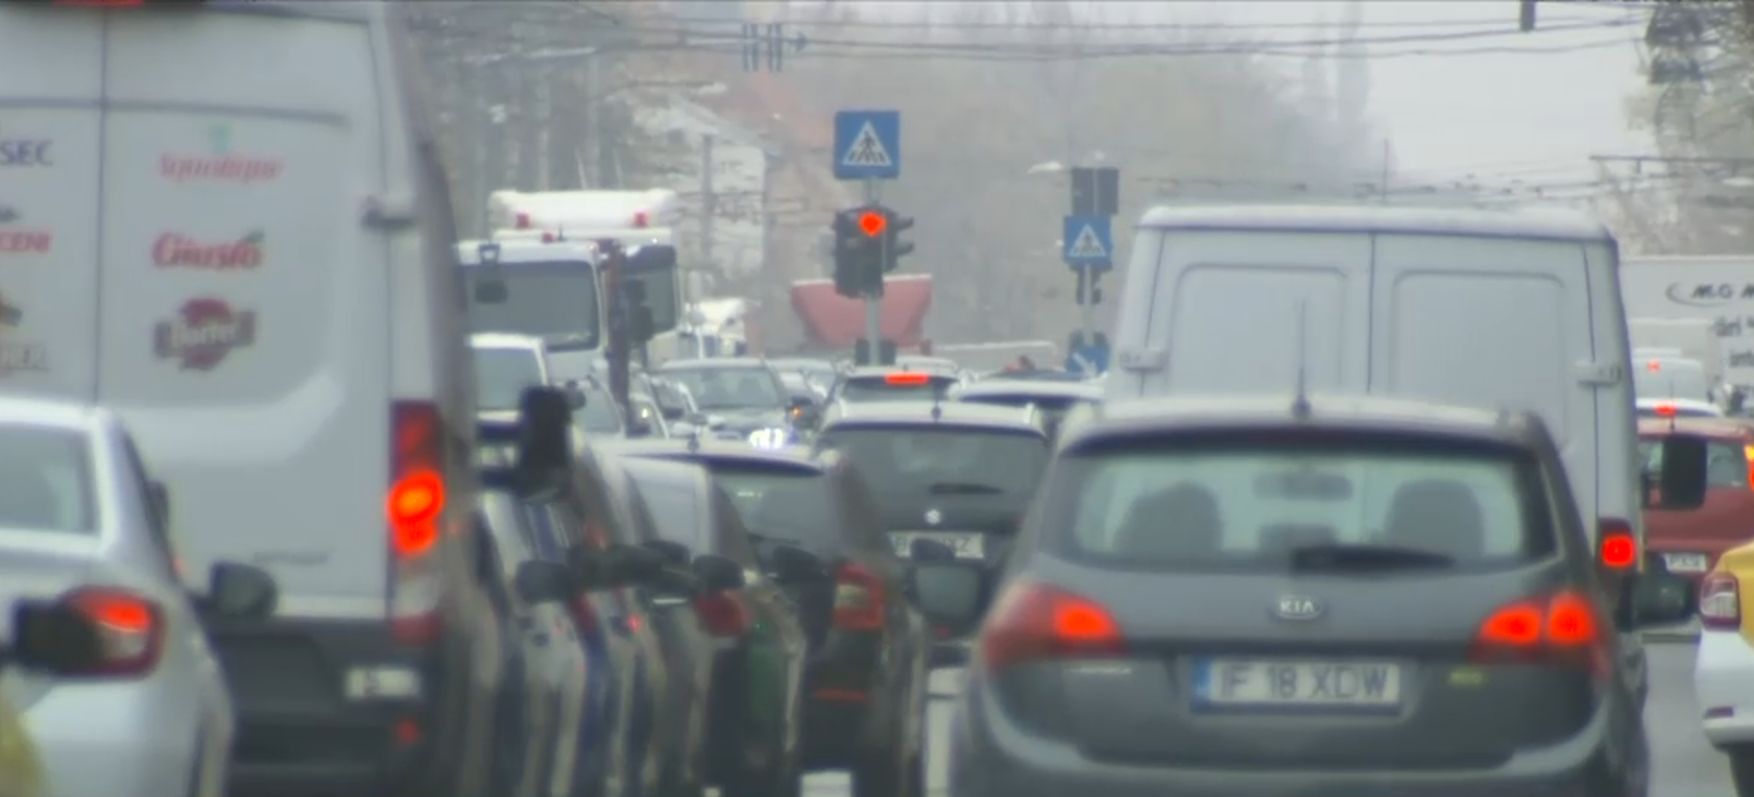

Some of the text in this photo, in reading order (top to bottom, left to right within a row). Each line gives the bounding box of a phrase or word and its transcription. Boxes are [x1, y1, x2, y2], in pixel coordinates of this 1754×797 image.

[1279, 600, 1316, 613] KIA
[1220, 664, 1390, 699] IF 18 XDW
